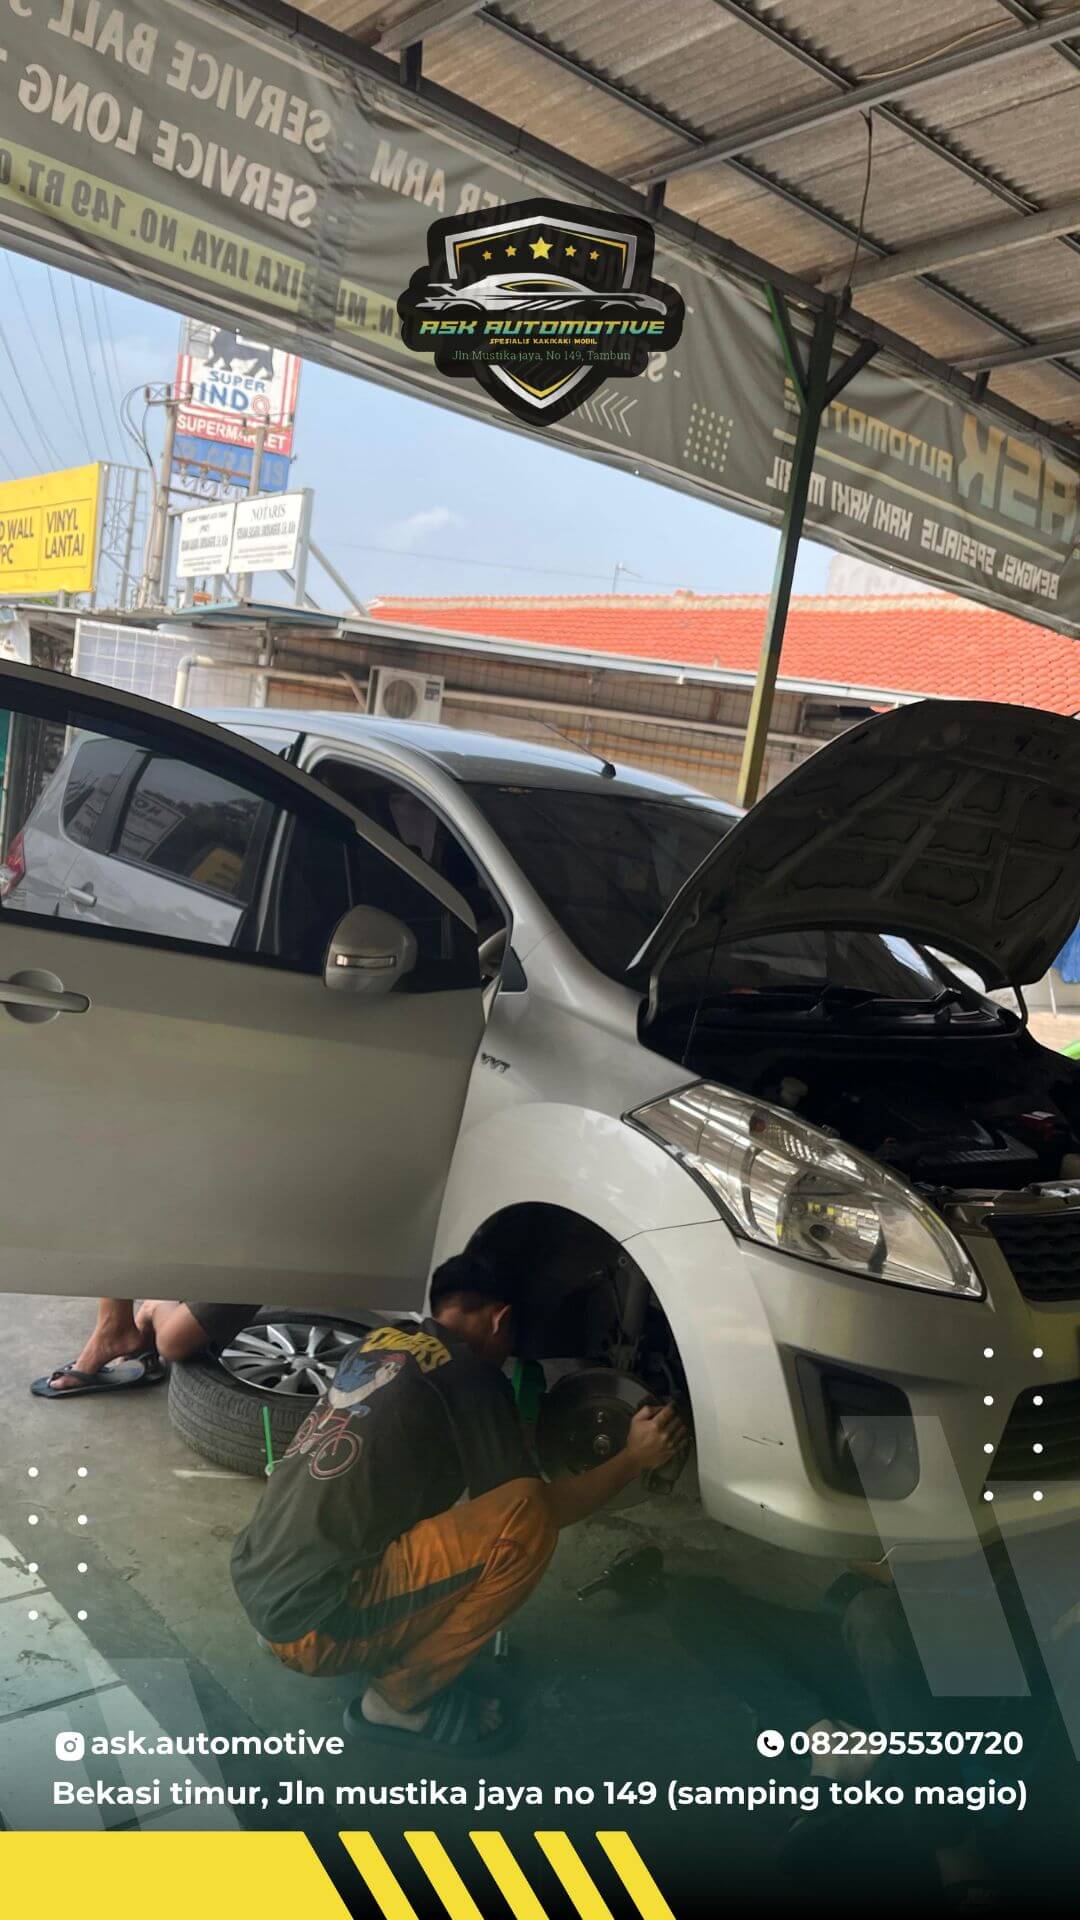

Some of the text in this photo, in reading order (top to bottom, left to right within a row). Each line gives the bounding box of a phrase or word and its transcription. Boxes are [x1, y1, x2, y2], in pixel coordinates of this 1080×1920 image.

[208, 370, 266, 393] SUPER
[8, 517, 34, 541] WALL
[46, 508, 78, 533] VINYL
[0, 543, 14, 564] PC
[45, 533, 84, 559] LANTAI
